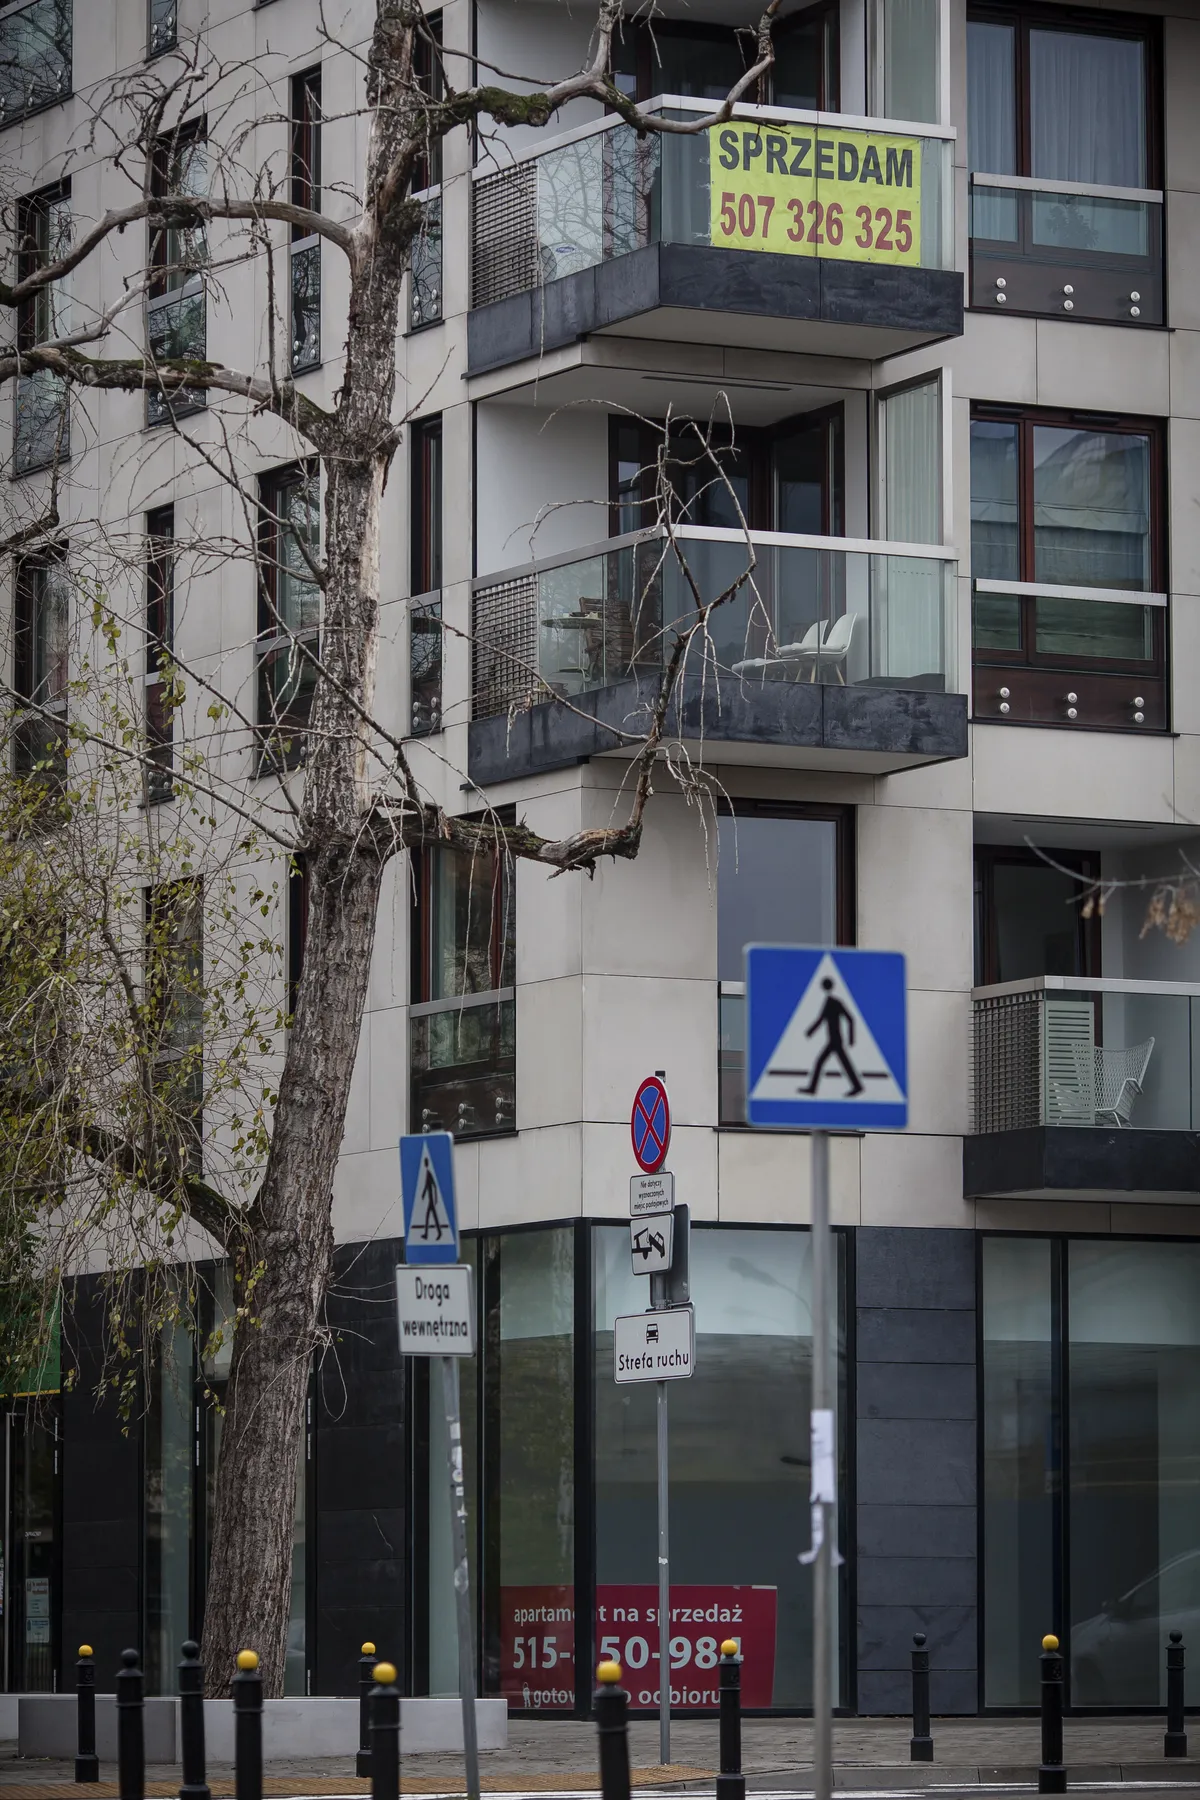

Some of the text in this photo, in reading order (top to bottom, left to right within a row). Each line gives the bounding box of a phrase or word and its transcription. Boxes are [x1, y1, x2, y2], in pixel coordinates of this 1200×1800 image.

[718, 129, 913, 188] SPRZEDAM
[720, 191, 913, 253] 507 326 325
[638, 1189, 665, 1200] wyznaczonych
[647, 1180, 662, 1189] dotyczy
[646, 1198, 669, 1210] postojowych
[415, 1276, 450, 1307] Droga
[403, 1315, 468, 1341] wewnętrzna
[618, 1349, 689, 1371] Strefa ruchu
[514, 1605, 607, 1627] apartamt
[613, 1607, 639, 1622] na
[513, 1635, 744, 1670] 515-50-98
